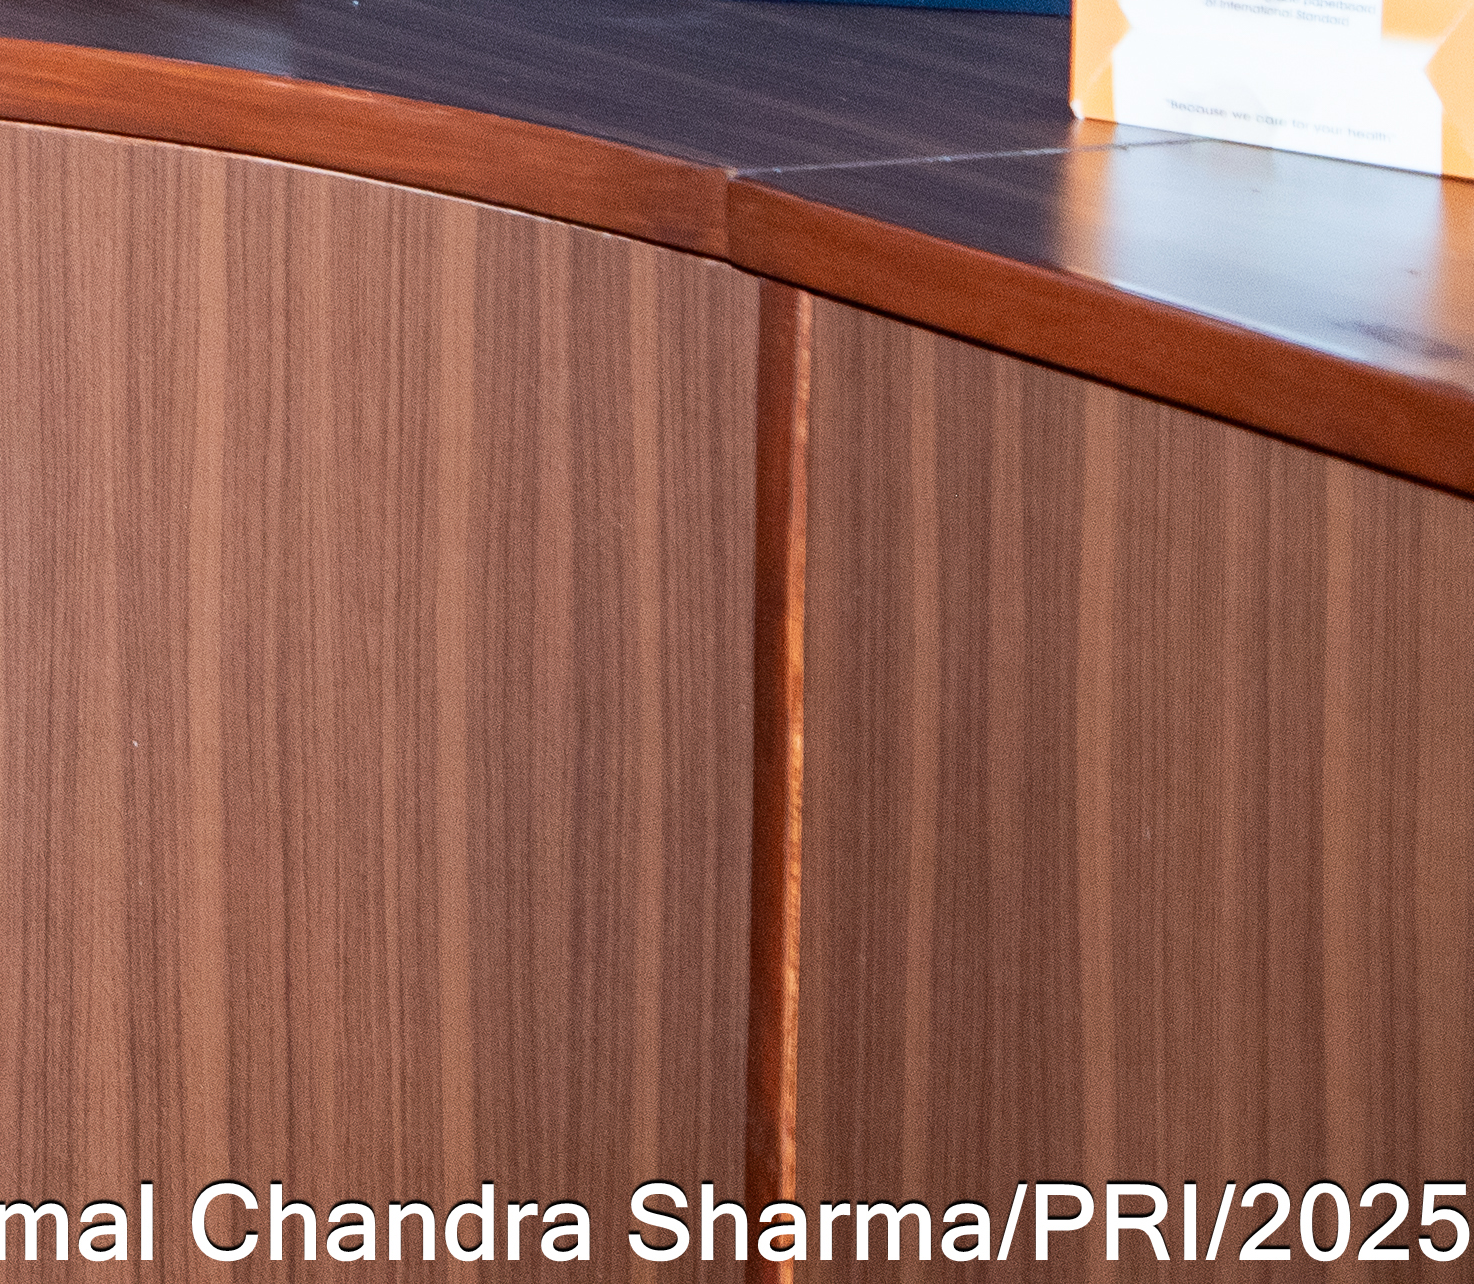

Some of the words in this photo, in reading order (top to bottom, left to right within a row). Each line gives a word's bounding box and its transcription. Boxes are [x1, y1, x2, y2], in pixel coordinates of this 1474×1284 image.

[1296, 10, 1350, 28] Standard
[1232, 110, 1252, 123] we
[1255, 115, 1288, 128] care
[1292, 118, 1310, 131] for
